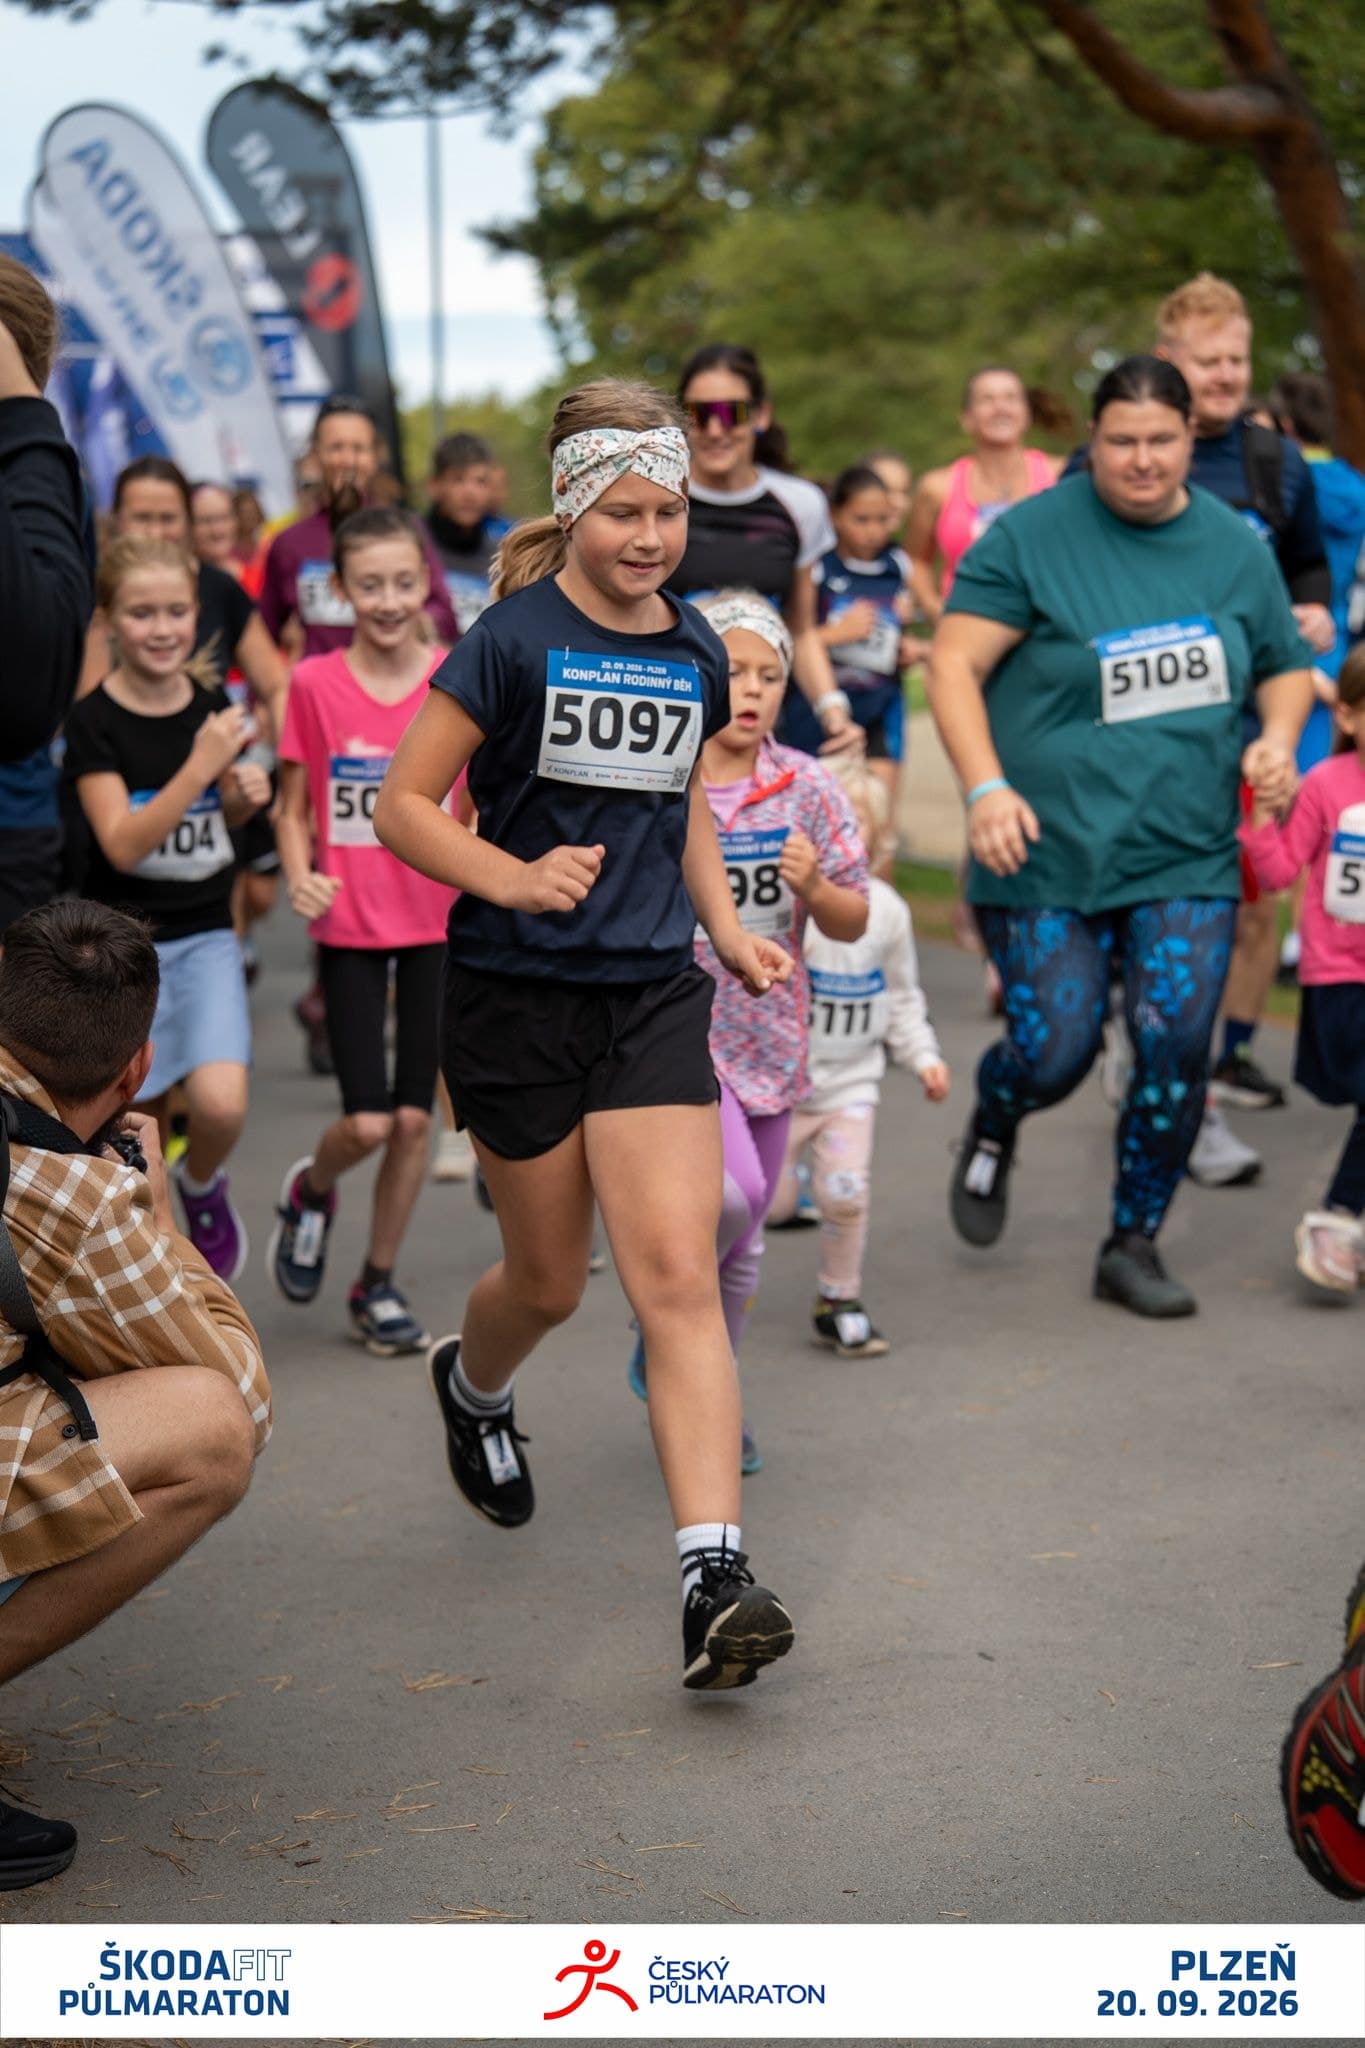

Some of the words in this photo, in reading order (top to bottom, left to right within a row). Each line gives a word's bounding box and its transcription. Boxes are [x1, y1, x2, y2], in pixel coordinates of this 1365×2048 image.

[562, 667, 620, 684] KONPLAN
[623, 674, 672, 690] RODINNÝ
[673, 677, 692, 692] BĚH
[1110, 645, 1209, 696] 5108
[548, 693, 692, 757] 5097
[334, 786, 375, 820] 50
[159, 817, 215, 855] 04
[728, 864, 782, 909] 98
[810, 1002, 872, 1036] 111
